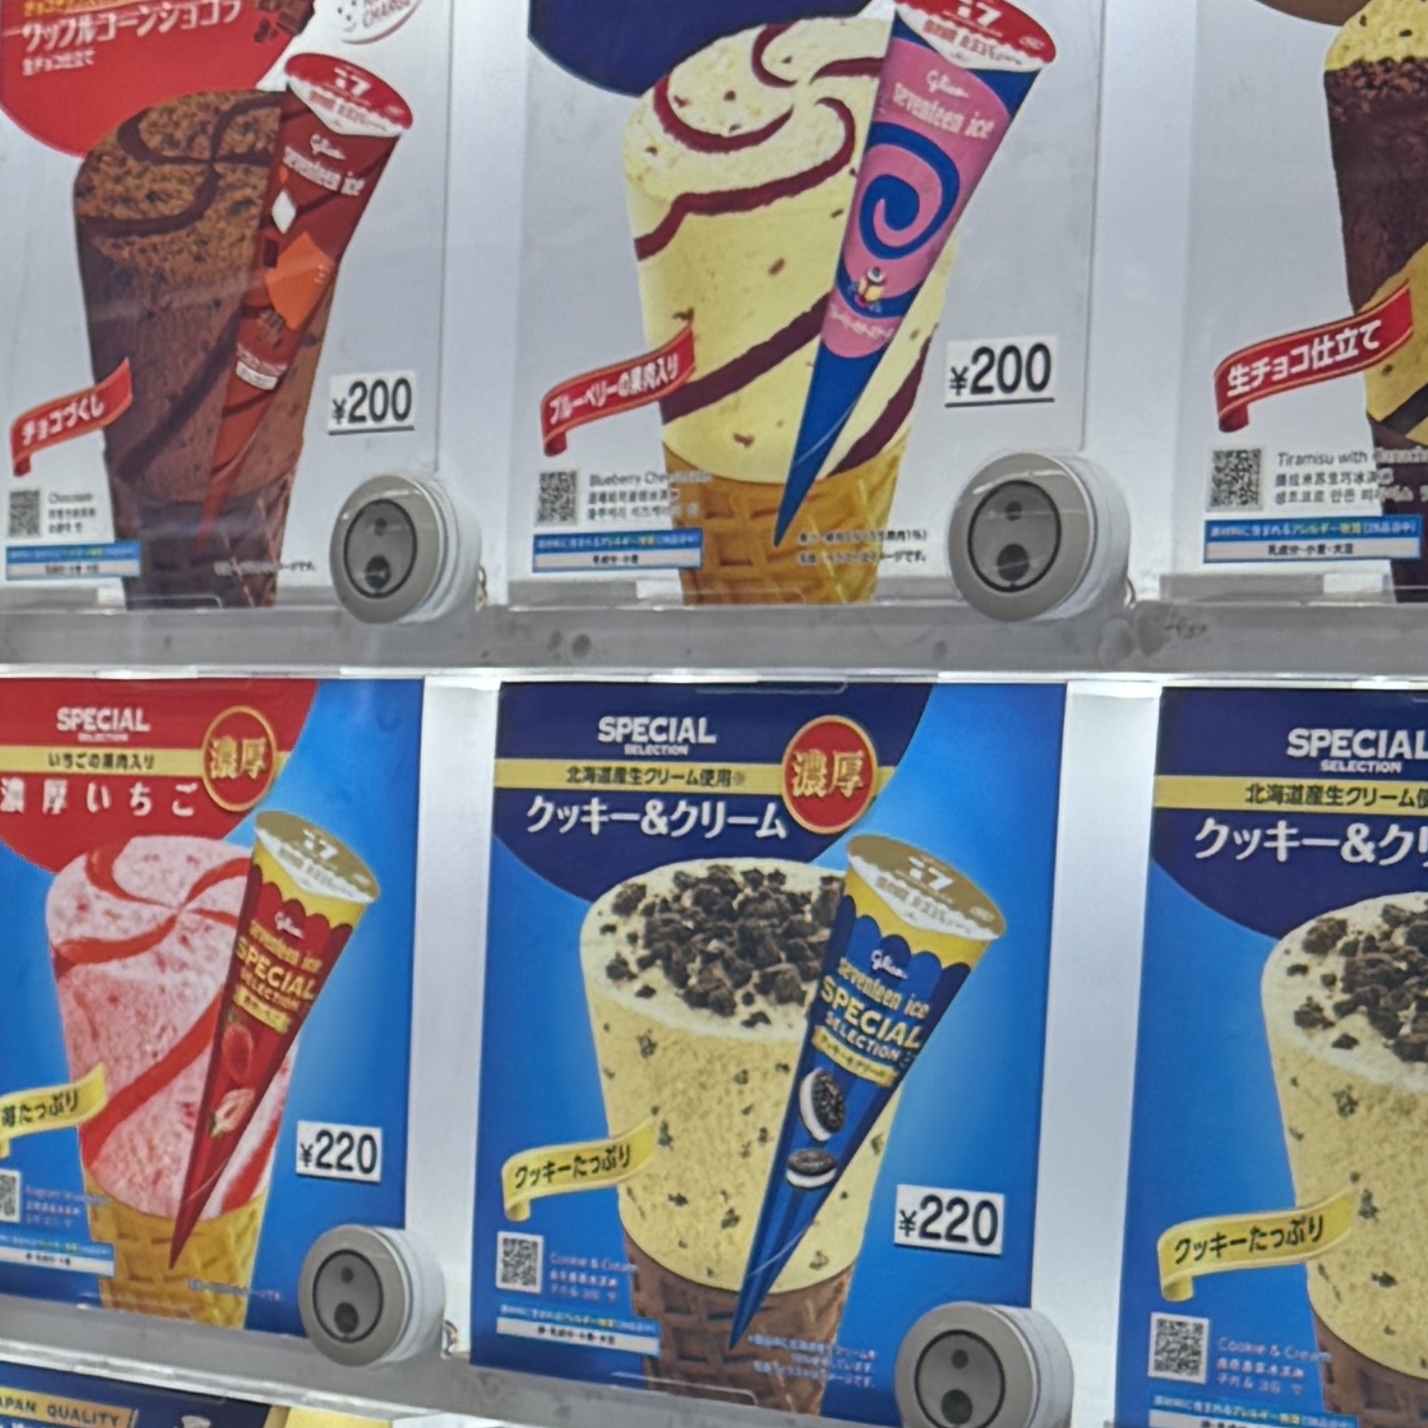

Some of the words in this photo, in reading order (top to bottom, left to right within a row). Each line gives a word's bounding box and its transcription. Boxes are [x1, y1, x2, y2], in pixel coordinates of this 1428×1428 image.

[23, 1, 240, 54] ワッフルコーンショコラ
[950, 342, 1051, 396] ¥200
[1227, 319, 1382, 400] 生チョコ仕立て
[331, 377, 412, 424] ¥200
[549, 352, 679, 424] ブルーベリーの果肉入り
[21, 393, 104, 446] チョコづくし
[1278, 451, 1334, 467] Tiramisu
[1338, 449, 1368, 465] with
[56, 707, 149, 732] SPECIAL
[598, 716, 717, 745] SPECIAL
[1286, 727, 1428, 760] SPECIAL
[209, 735, 267, 779] 濃厚
[791, 750, 864, 800] 濃厚
[1320, 760, 1402, 774] SELECTION
[0, 777, 199, 817] 濃厚いちご
[526, 795, 788, 840] クッキー&クリーム
[236, 936, 315, 1000] SPECIAL
[838, 956, 902, 1012] seventeen
[903, 989, 930, 1020] ice
[820, 975, 923, 1050] SPECIAL
[825, 1011, 902, 1061] SELECTION
[300, 1129, 377, 1174] ¥220
[514, 1142, 631, 1189] クッキーたっぷり
[899, 1194, 999, 1246] ¥220
[1175, 1215, 1324, 1264] クッキーたっぷり
[47, 1403, 120, 1428] QUALITY
